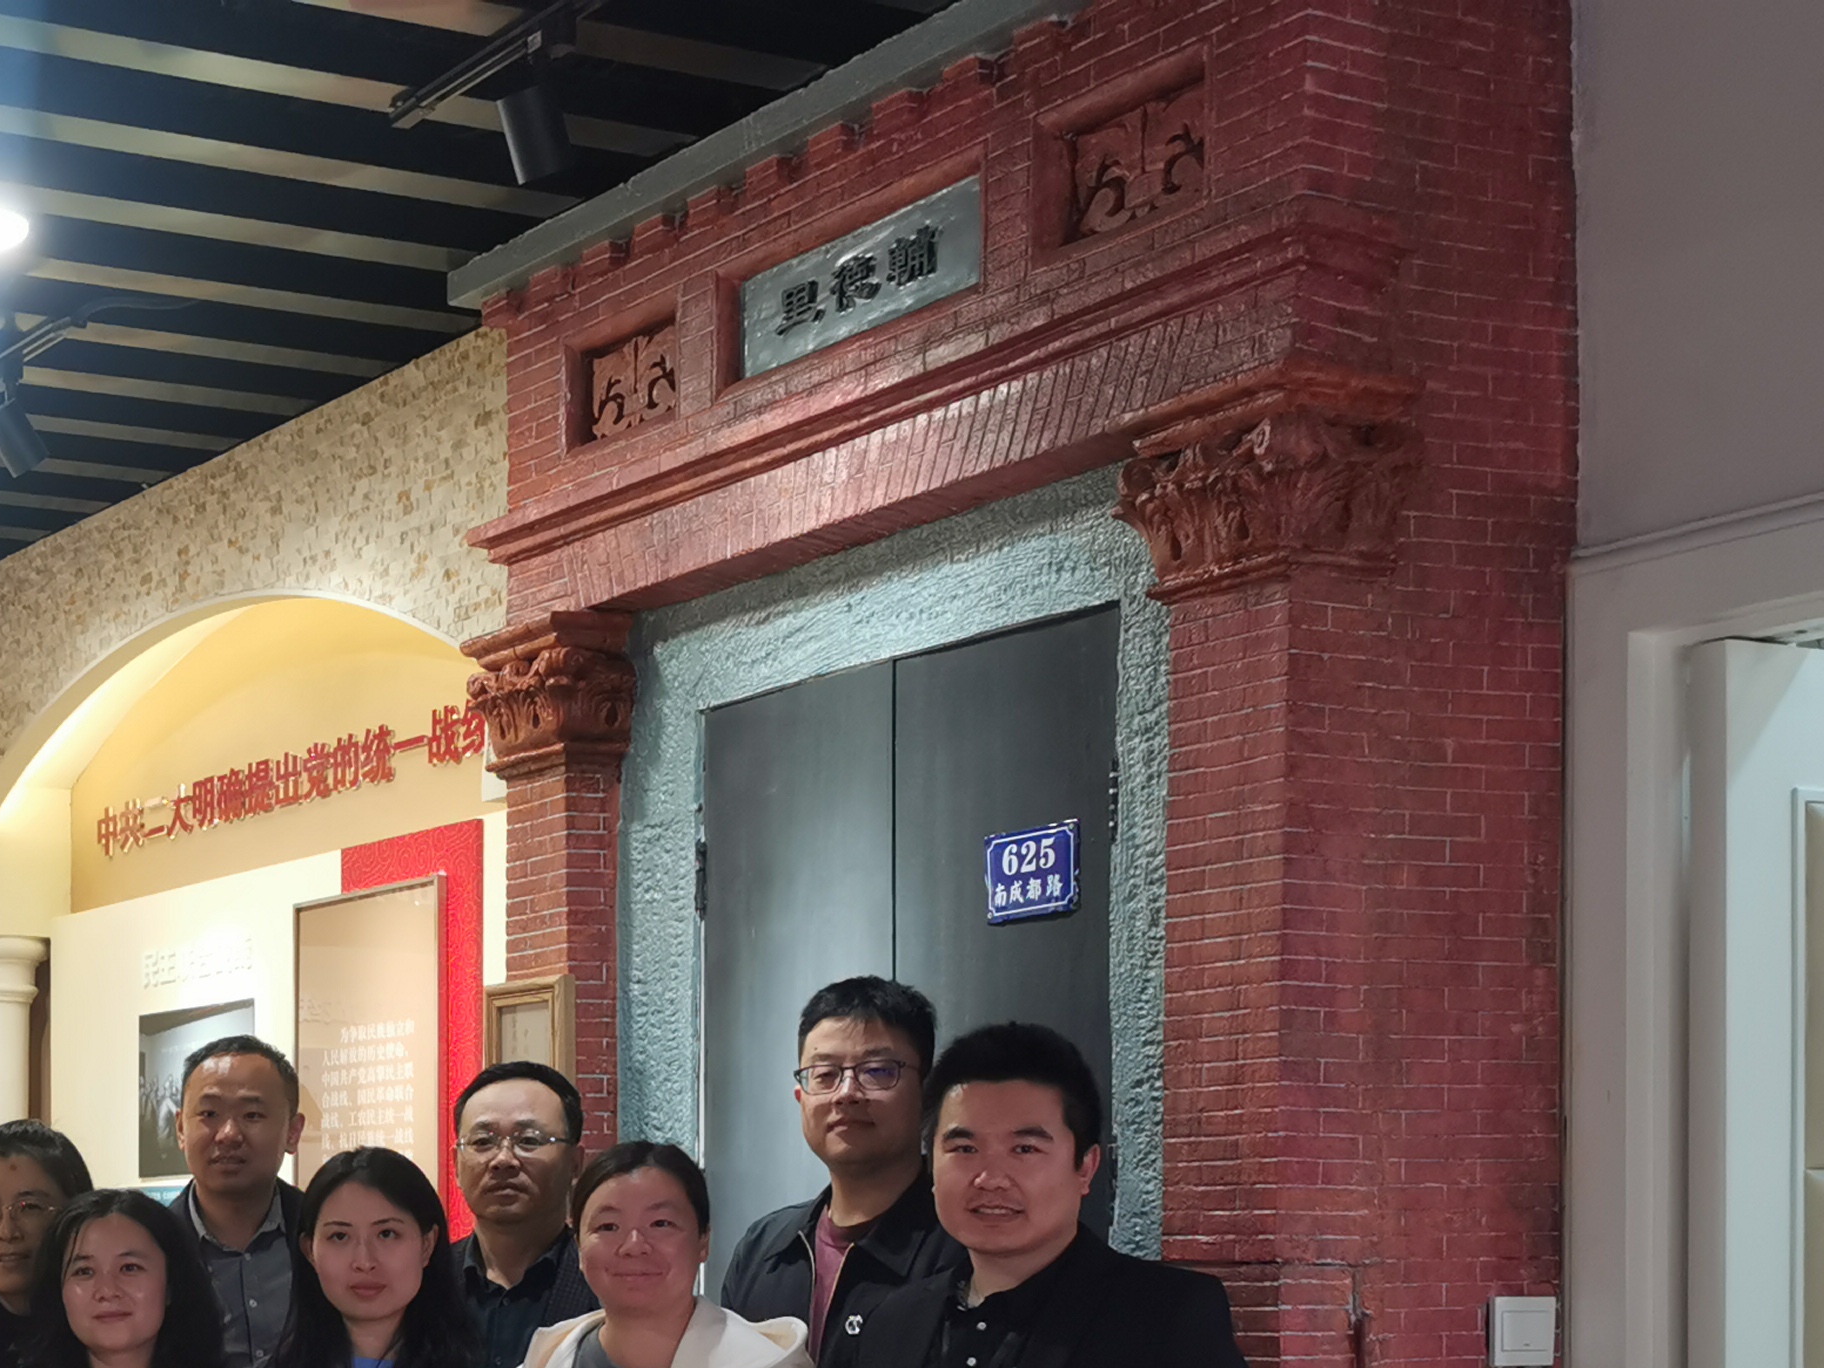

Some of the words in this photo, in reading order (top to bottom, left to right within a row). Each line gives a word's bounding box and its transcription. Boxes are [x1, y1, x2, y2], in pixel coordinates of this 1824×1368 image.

[1002, 837, 1056, 876] 625
[994, 874, 1064, 907] 南成都路
